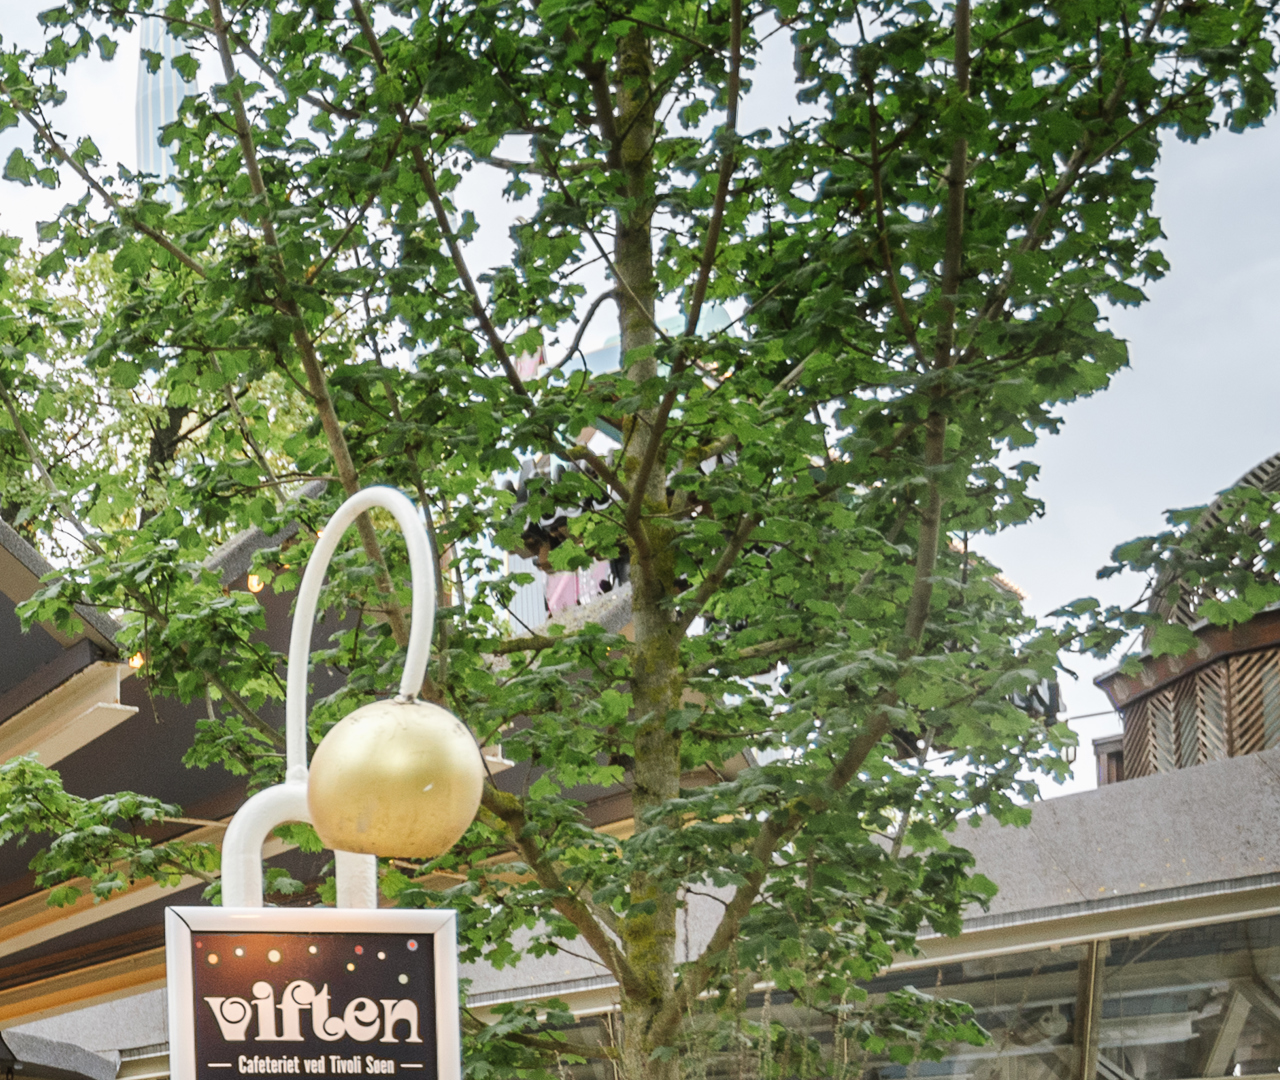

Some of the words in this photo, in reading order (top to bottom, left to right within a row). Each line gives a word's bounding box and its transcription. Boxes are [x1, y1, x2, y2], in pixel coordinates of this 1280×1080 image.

[204, 980, 423, 1043] viften
[238, 1055, 300, 1074] Cafeteriet
[304, 1055, 325, 1073] ved
[330, 1055, 362, 1074] Tivoli
[366, 1055, 395, 1074] Søen
